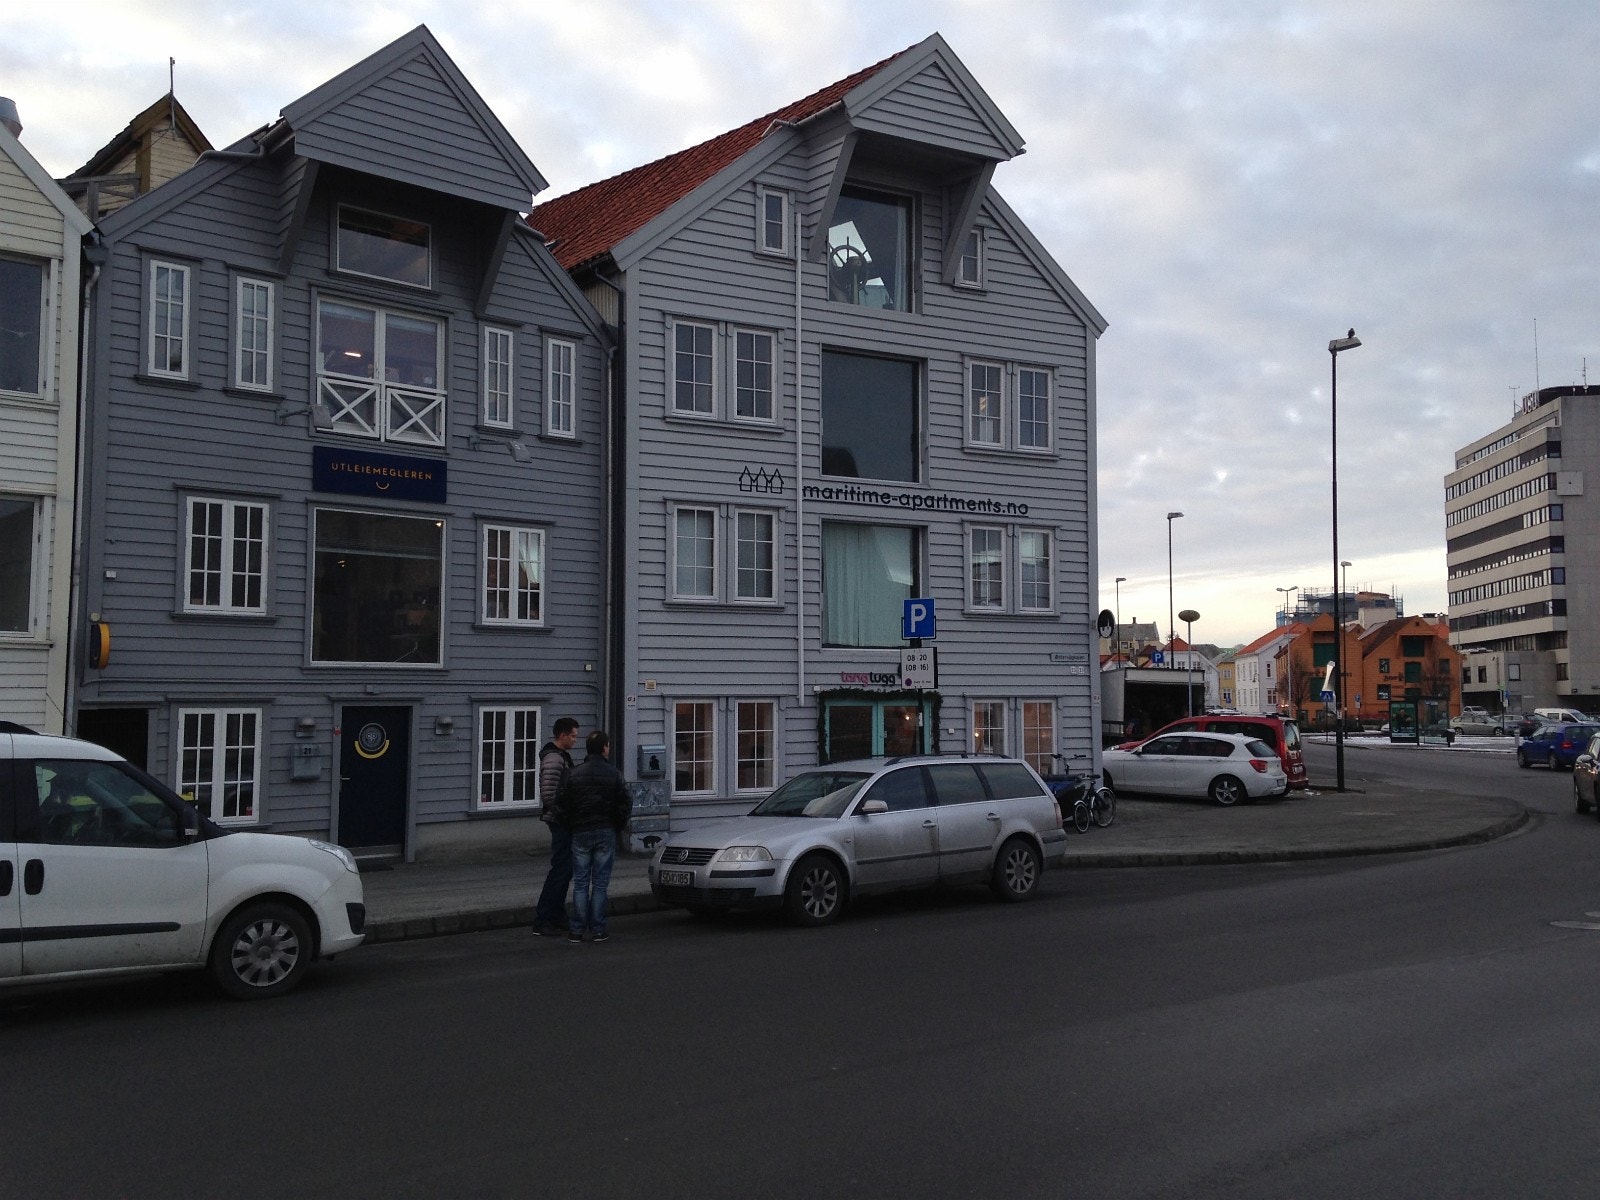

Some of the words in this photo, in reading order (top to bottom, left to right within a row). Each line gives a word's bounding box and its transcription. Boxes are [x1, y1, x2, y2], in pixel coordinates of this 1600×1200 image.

[331, 462, 432, 480] UTLEIEMEGLEREN
[802, 484, 1029, 515] maritime-apartments.no
[910, 603, 927, 633] P
